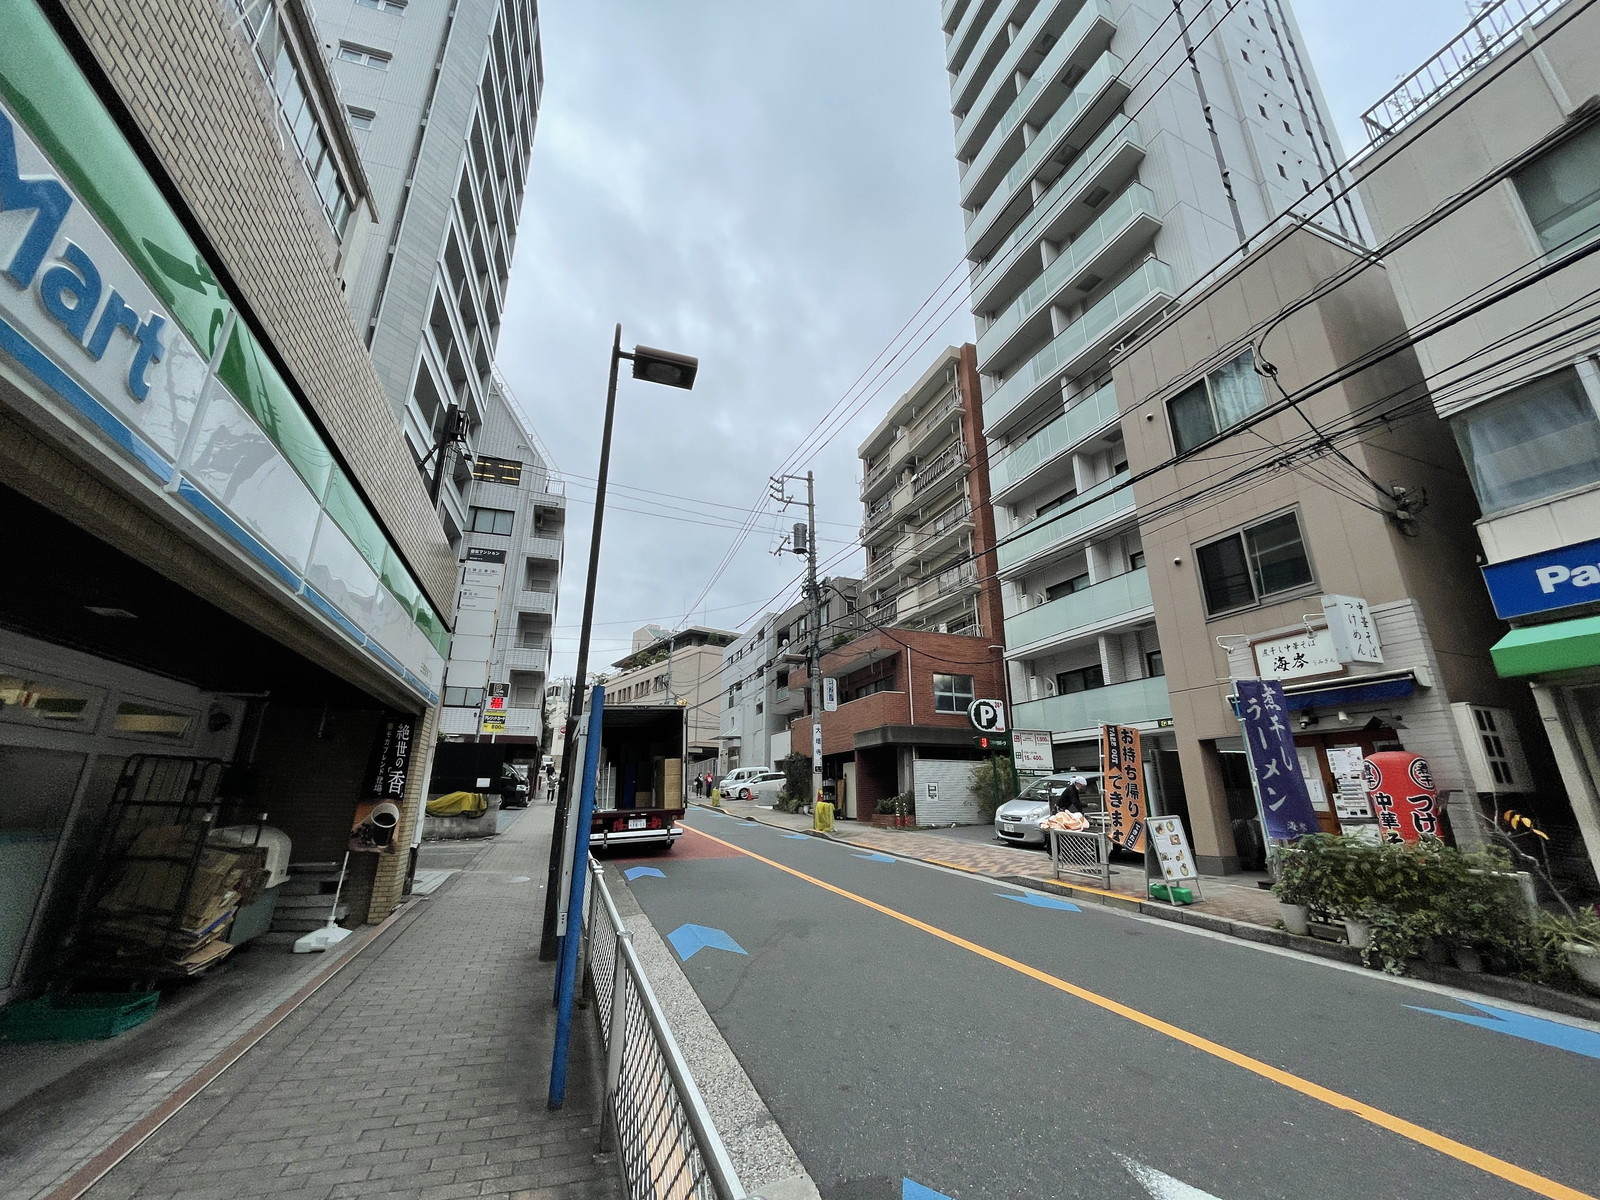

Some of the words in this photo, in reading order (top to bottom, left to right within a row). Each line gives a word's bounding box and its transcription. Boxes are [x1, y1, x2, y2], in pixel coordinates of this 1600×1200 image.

[0, 107, 166, 404] Mart
[1535, 565, 1600, 594] Pa
[1344, 603, 1366, 656] つけめん
[1356, 602, 1378, 658] 中華そば
[1246, 697, 1287, 812] ラーメン
[1261, 683, 1292, 771] 煮干し
[1121, 728, 1139, 818] お持ち帰り
